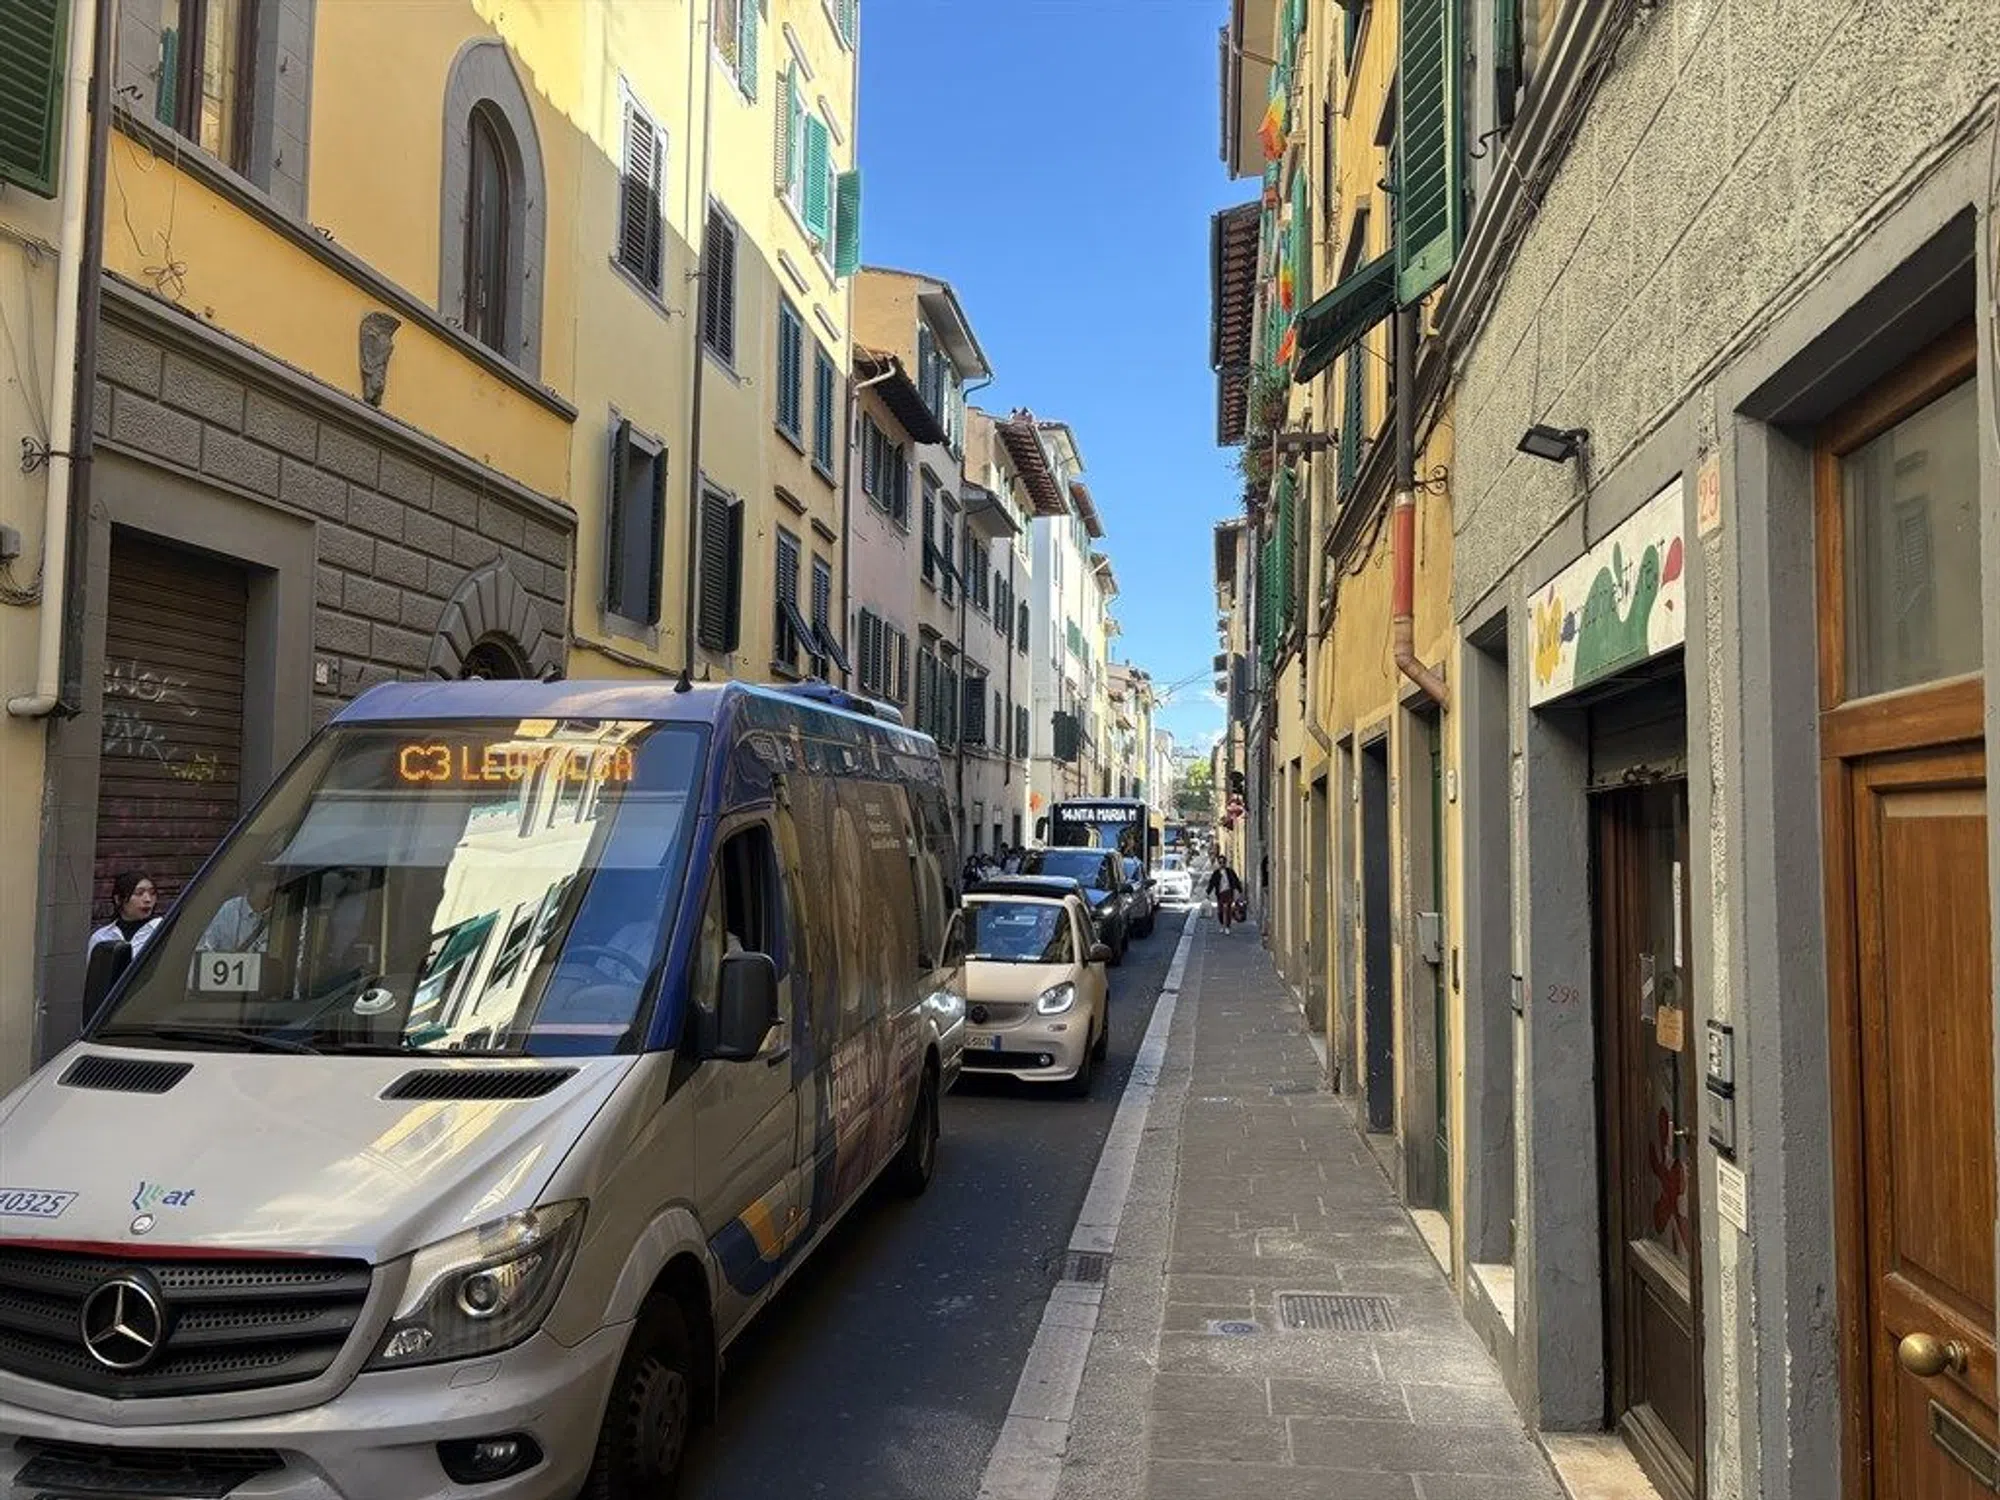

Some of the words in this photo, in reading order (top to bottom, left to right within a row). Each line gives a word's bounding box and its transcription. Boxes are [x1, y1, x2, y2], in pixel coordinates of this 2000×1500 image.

[1699, 471, 1719, 523] 29
[400, 745, 451, 781] C3
[1096, 808, 1126, 821] MARIA
[213, 960, 244, 986] 91
